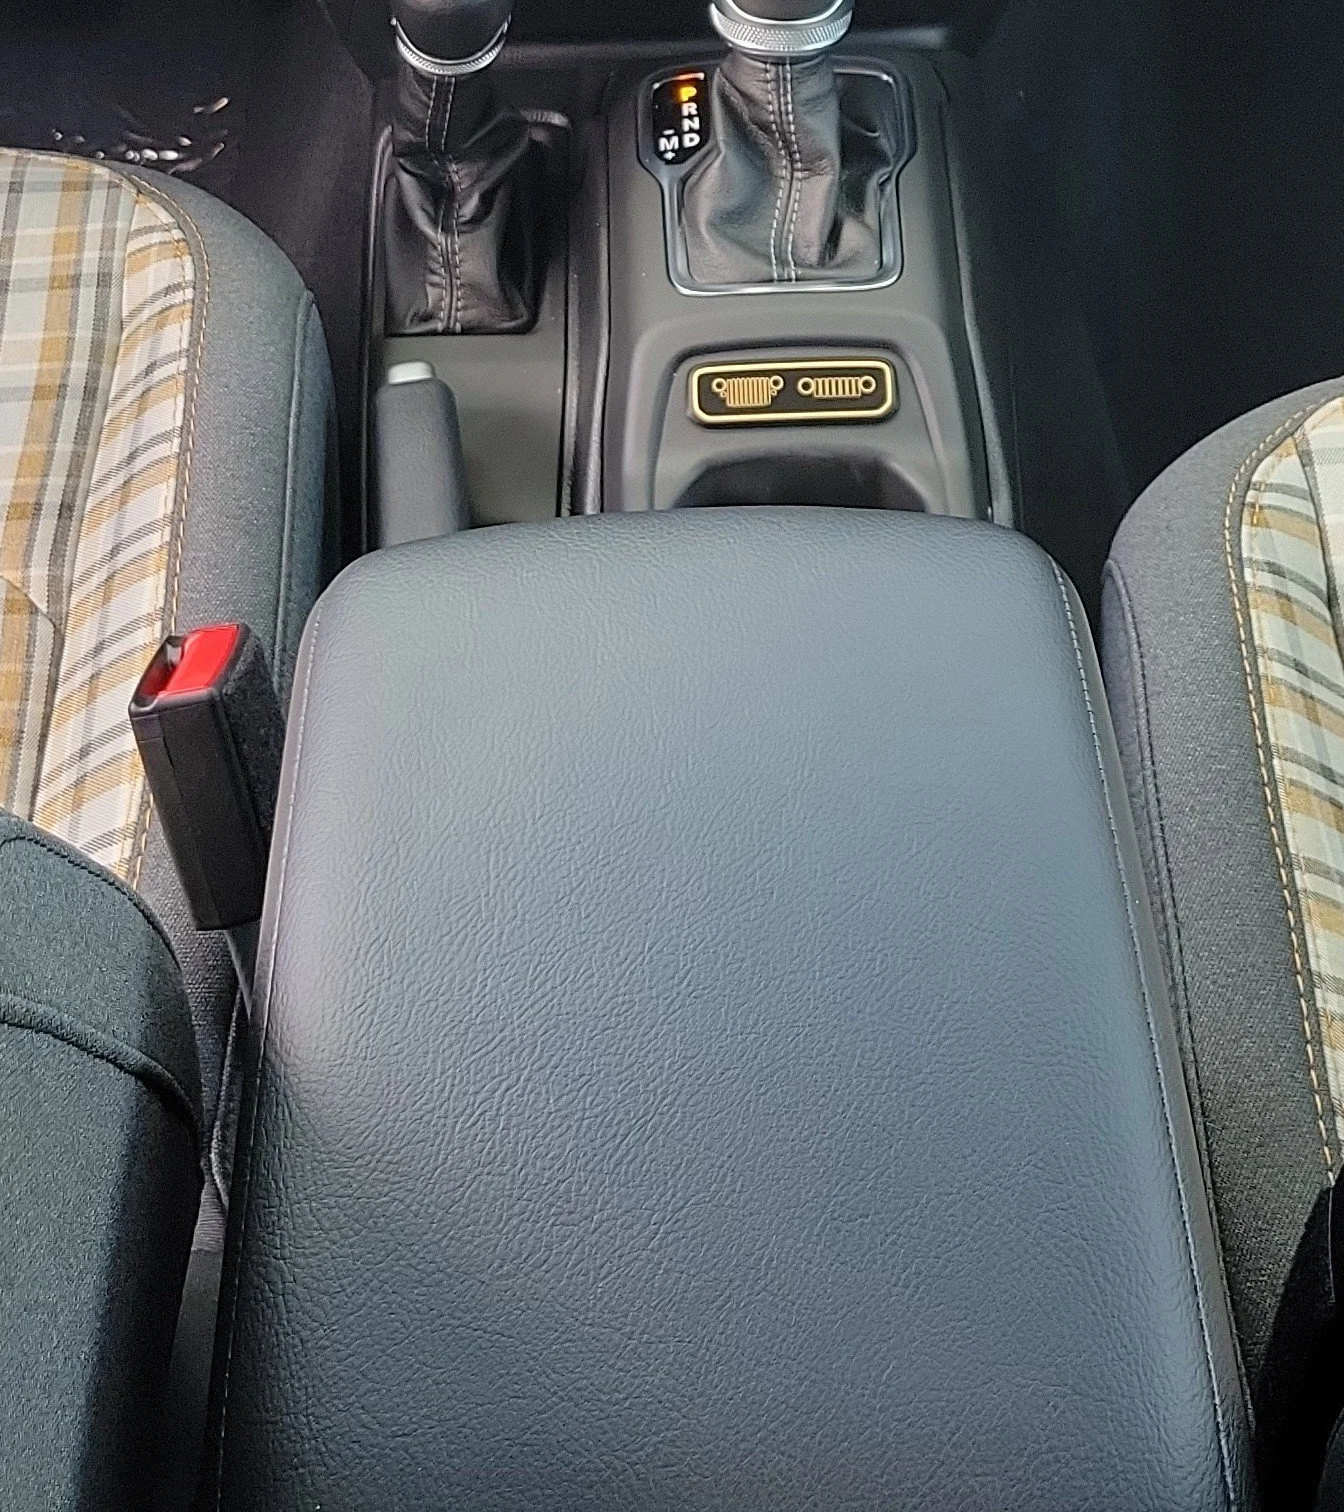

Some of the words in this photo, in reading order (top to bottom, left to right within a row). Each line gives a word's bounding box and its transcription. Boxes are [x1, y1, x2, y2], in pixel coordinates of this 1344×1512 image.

[680, 87, 697, 101] P
[681, 102, 698, 116] R
[682, 117, 700, 132] N
[659, 136, 679, 151] M
[683, 133, 700, 148] D
